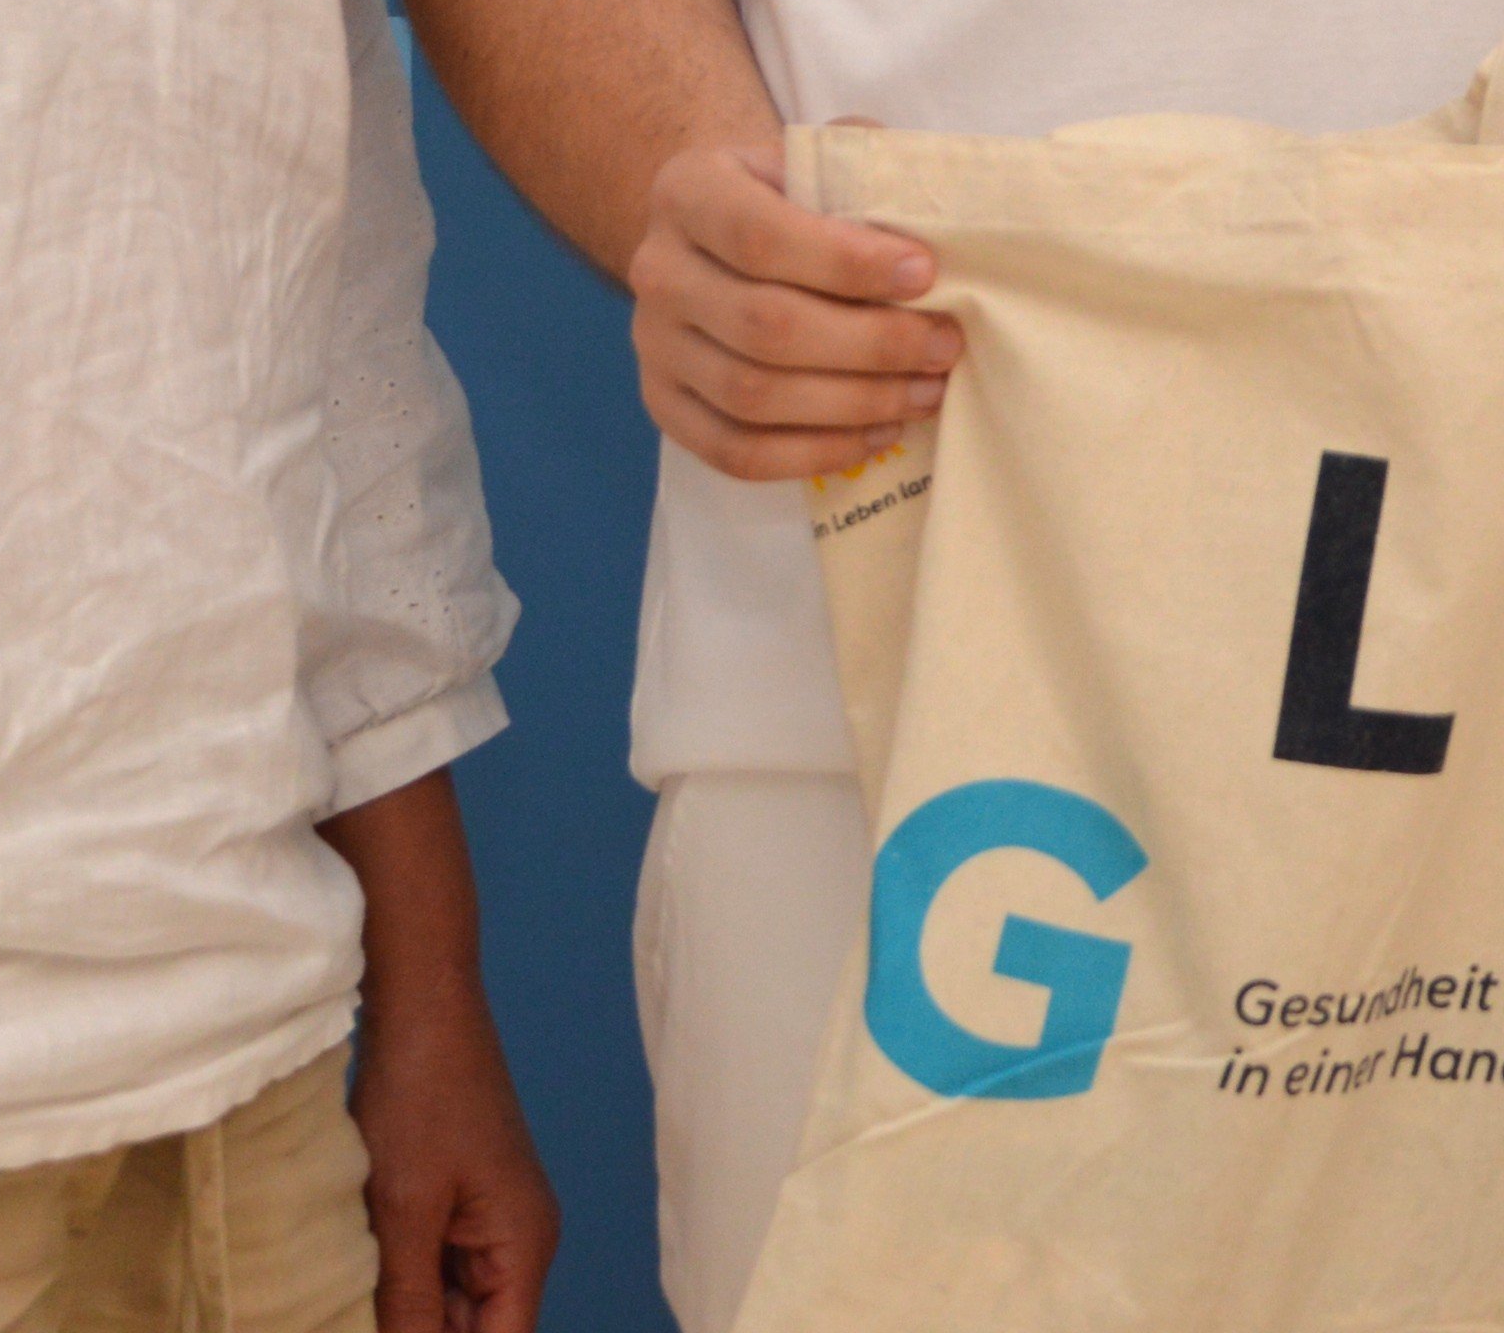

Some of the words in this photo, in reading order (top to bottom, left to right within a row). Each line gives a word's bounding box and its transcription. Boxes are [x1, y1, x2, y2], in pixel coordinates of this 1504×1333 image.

[1272, 448, 1456, 776] L
[864, 777, 1150, 1101] G
[1234, 965, 1500, 1029] Gesundheit
[1216, 1046, 1272, 1097] in
[1284, 1045, 1386, 1096] einer
